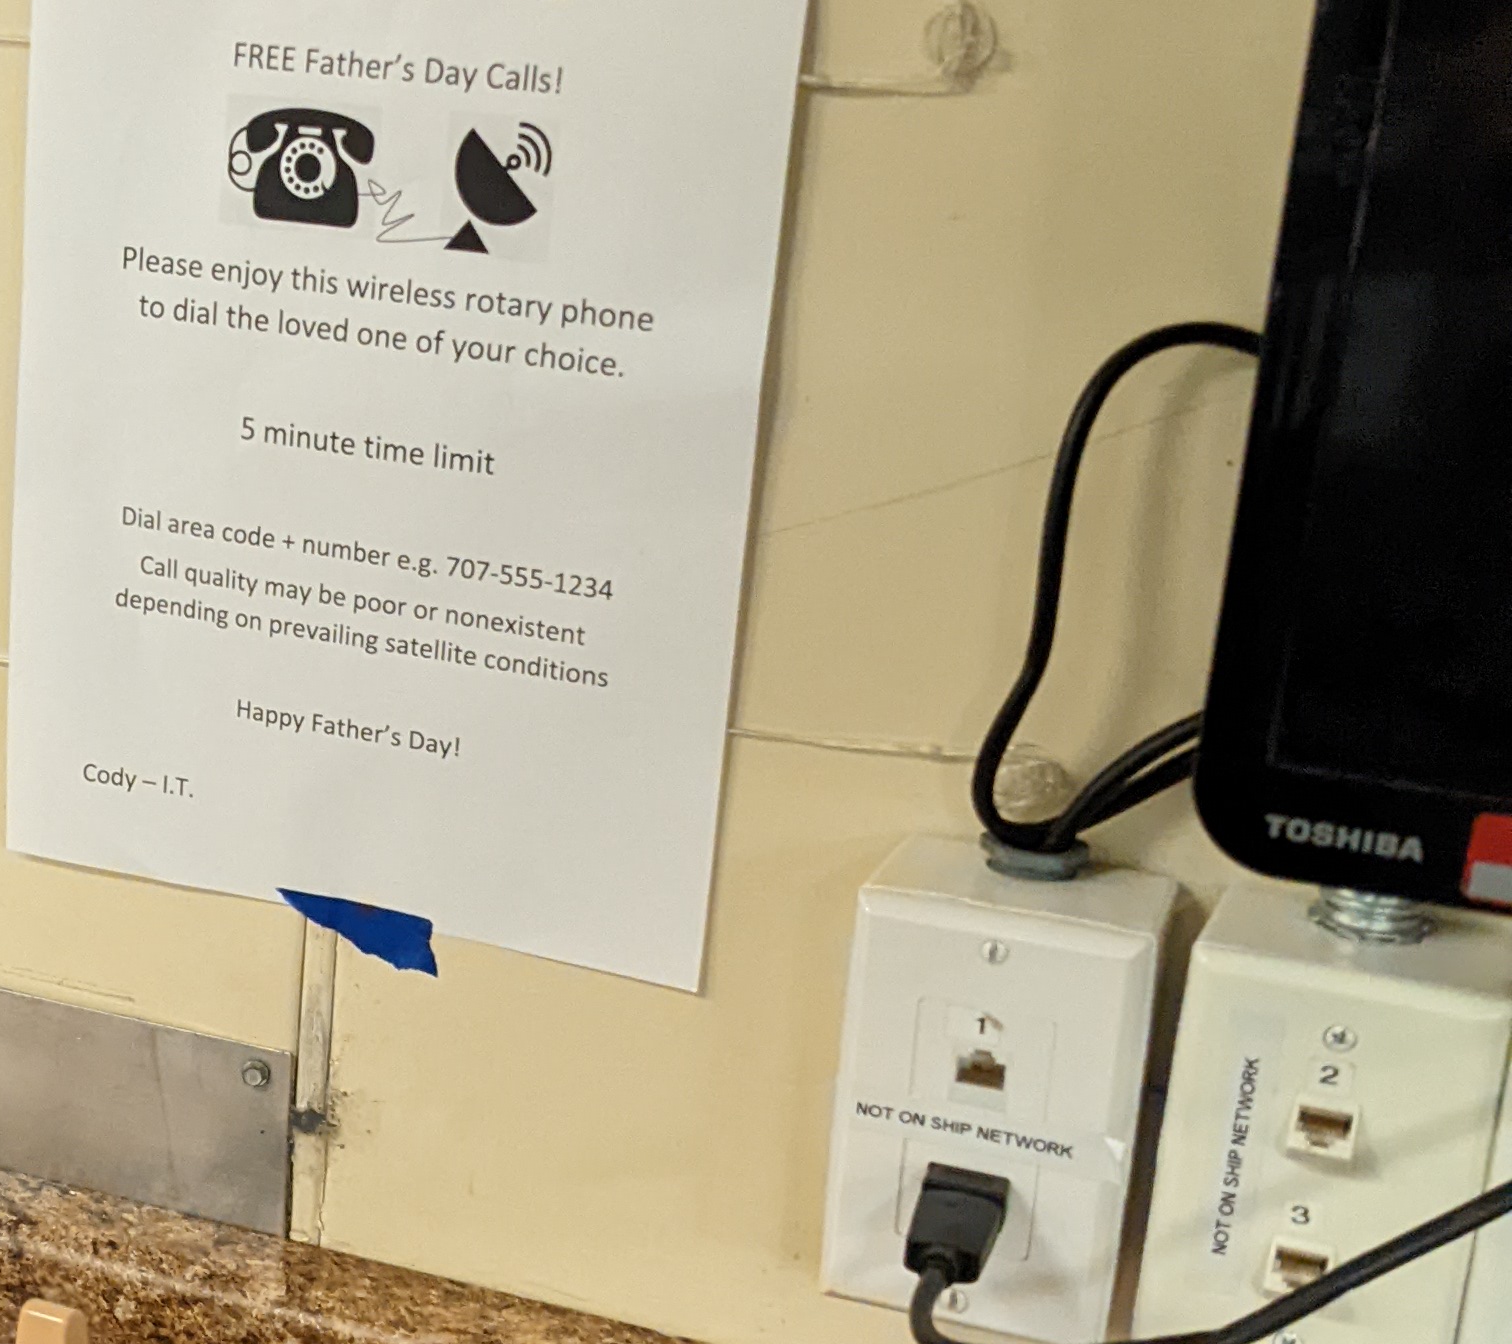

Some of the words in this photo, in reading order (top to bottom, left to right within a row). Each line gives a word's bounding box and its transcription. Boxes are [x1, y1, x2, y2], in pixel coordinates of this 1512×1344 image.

[233, 41, 296, 72] FREE
[305, 48, 415, 83] Father’s
[424, 56, 479, 94] Day
[486, 62, 563, 95] Calls!
[122, 245, 203, 279] Please
[211, 259, 284, 294] enjoy
[290, 265, 338, 295] this
[346, 275, 456, 310] wireless
[465, 292, 554, 326] rotary
[560, 298, 654, 332] phone
[138, 295, 165, 319] to
[173, 297, 218, 326] dial
[225, 304, 270, 333] the
[278, 308, 349, 343] loved
[357, 327, 408, 351] one
[415, 329, 446, 355] of
[451, 338, 517, 364] your
[524, 341, 624, 378] choice.
[240, 416, 255, 441] 5
[263, 422, 356, 456] minute
[363, 435, 425, 466] time
[433, 442, 496, 476] limit
[122, 505, 162, 531] Dial
[167, 517, 215, 540] area
[221, 525, 275, 549] code
[302, 534, 391, 567] number
[397, 554, 438, 578] e.g.
[446, 556, 614, 601] 707-555-1234
[140, 555, 178, 580] Call
[184, 567, 259, 598] quality
[264, 580, 313, 606] may
[318, 582, 346, 607] be
[353, 594, 408, 617] poor
[413, 604, 439, 621] or
[445, 608, 586, 647] nonexistent
[115, 587, 229, 630] depending
[235, 612, 262, 631] on
[269, 618, 379, 655] prevailing
[384, 637, 477, 666] satellite
[484, 653, 609, 688] conditions
[236, 698, 306, 734] Happy
[311, 713, 402, 747] Father’s
[409, 730, 461, 760] Day!
[82, 763, 138, 793] Cody
[162, 774, 194, 799] I.T.
[1264, 812, 1424, 865] TOSHIBA
[977, 1017, 986, 1034] 1
[1230, 1056, 1261, 1147] NETWORK
[1318, 1064, 1340, 1086] 2
[855, 1101, 894, 1120] NOT
[898, 1110, 926, 1127] ON
[930, 1115, 973, 1136] SHIP
[976, 1125, 1075, 1160] NETWORK
[1223, 1148, 1243, 1188] SHIP
[1218, 1190, 1237, 1218] ON
[1290, 1204, 1311, 1226] 3
[1211, 1219, 1233, 1256] NOT
